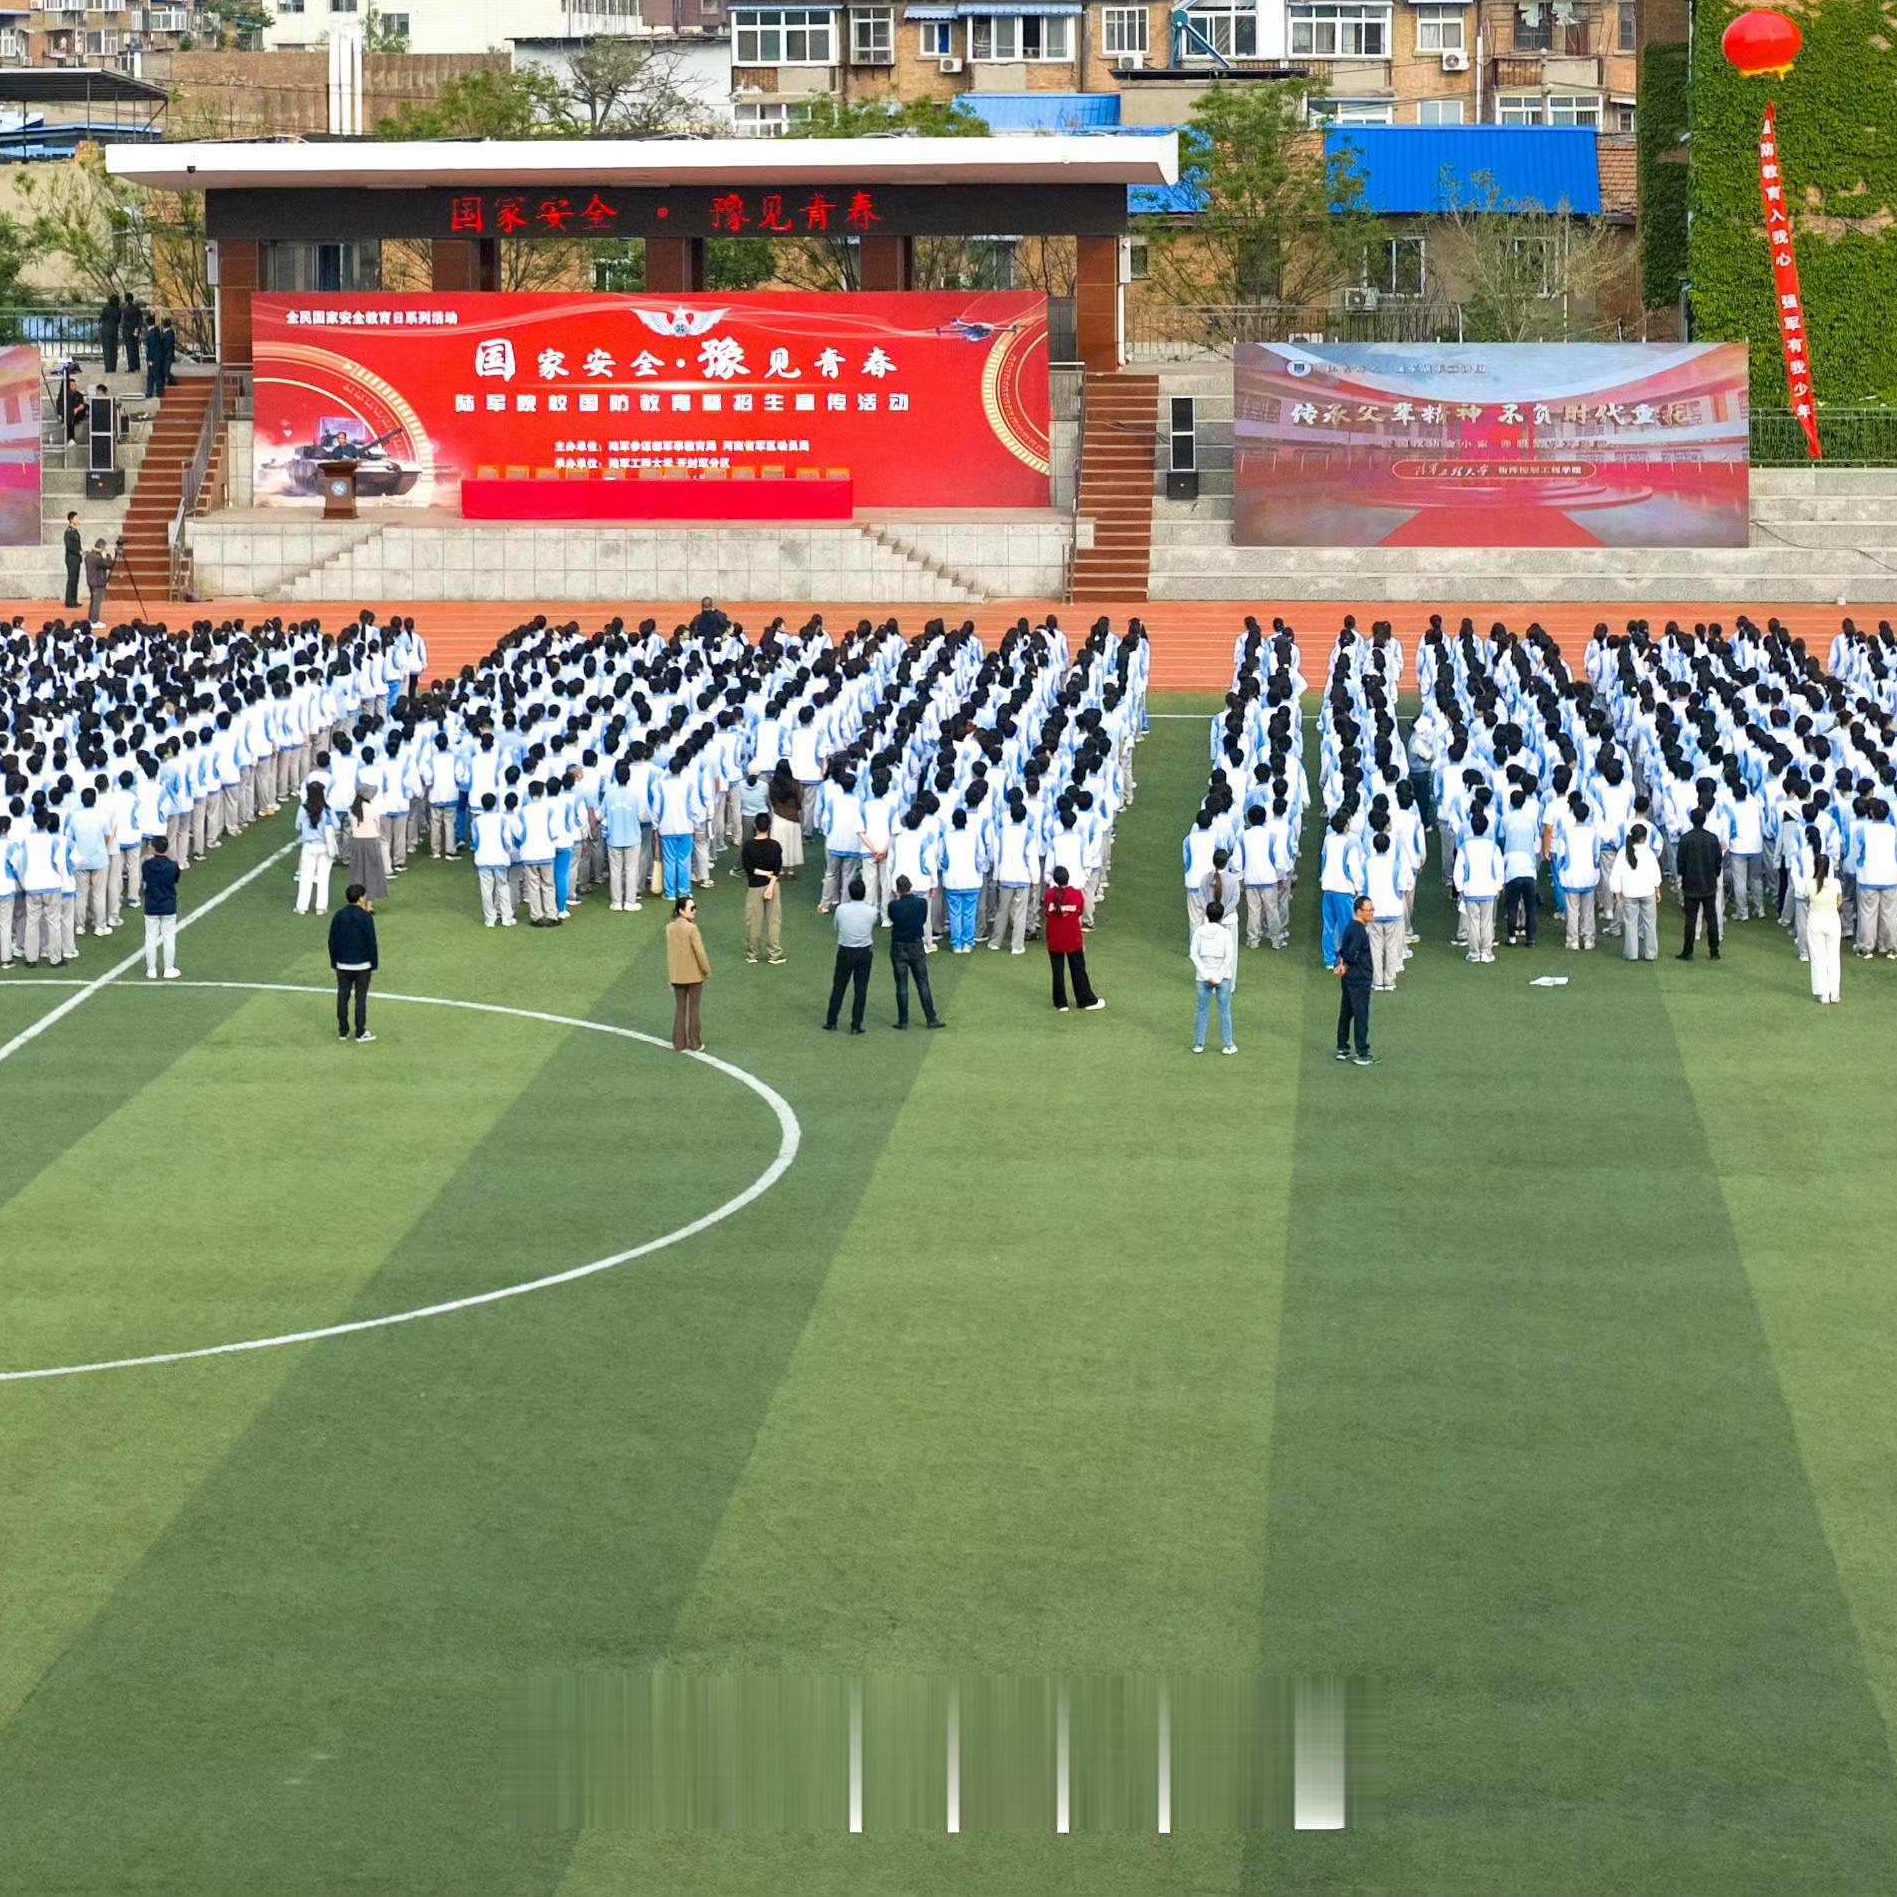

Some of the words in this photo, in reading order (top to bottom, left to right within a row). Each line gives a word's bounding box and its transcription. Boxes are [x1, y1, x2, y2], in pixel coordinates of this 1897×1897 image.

[451, 194, 617, 234] 国家安全
[711, 191, 883, 234] 豫见青春
[286, 310, 459, 325] 全民国家安全教育日系列活动
[455, 393, 910, 413] 陆军院校国防教育暨招生宣传活动
